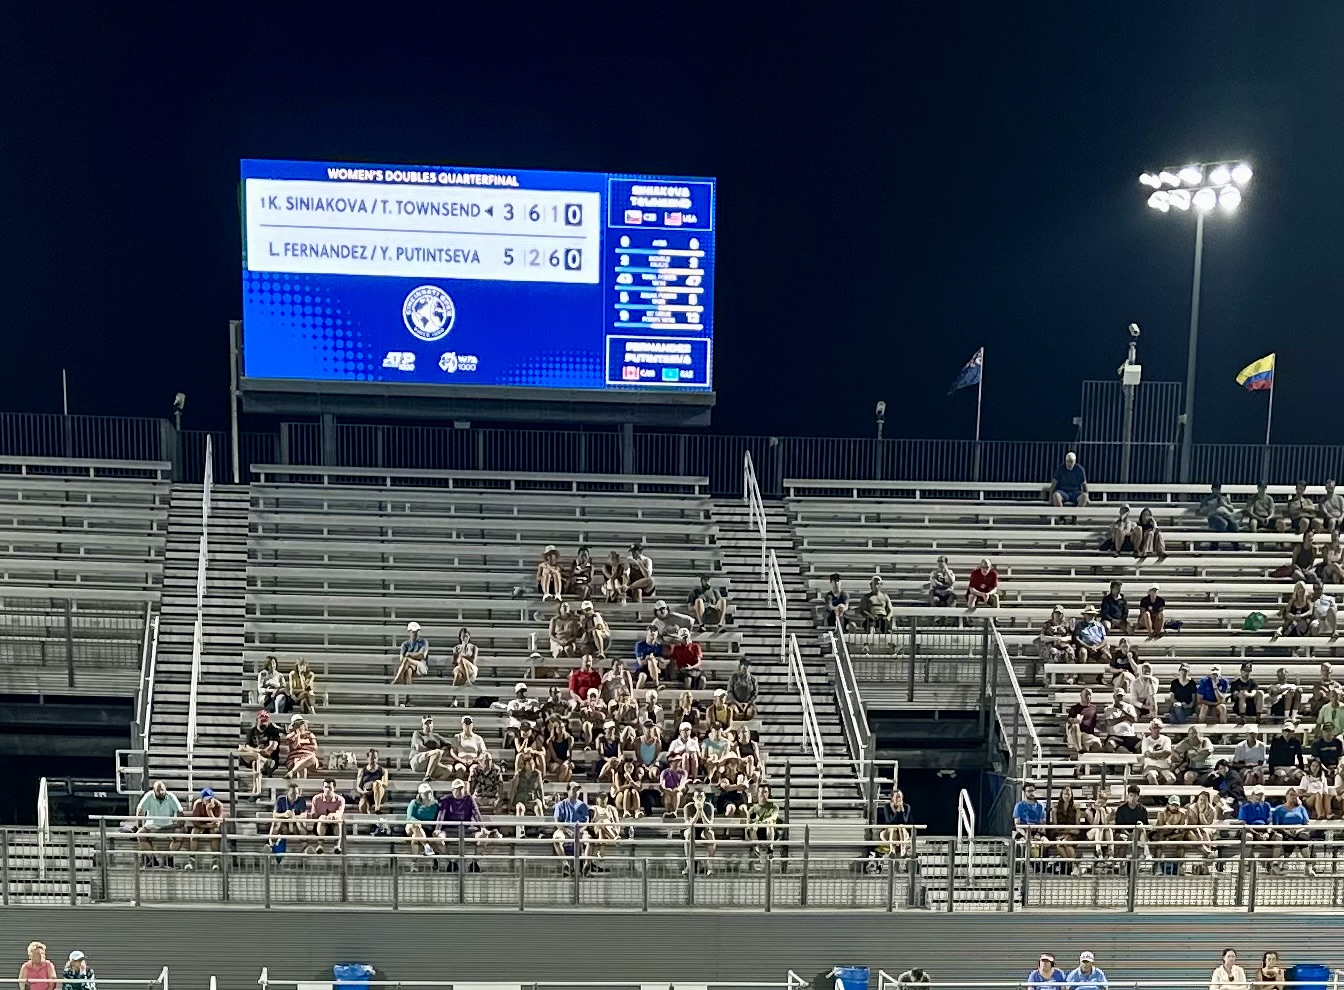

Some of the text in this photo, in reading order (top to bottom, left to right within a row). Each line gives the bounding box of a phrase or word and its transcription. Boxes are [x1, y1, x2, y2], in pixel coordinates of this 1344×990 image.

[327, 168, 519, 187] WOMEN'S DOUBLES QUARTERFINAL
[268, 196, 281, 210] K.
[285, 196, 368, 213] SINIAKOVA
[380, 199, 392, 214] T.
[396, 200, 480, 217] TOWNSEND
[503, 203, 514, 221] 3
[528, 203, 540, 222] 6
[268, 242, 280, 256] L.
[284, 242, 368, 260] FERNANDEZ
[379, 245, 392, 261] Y.
[396, 246, 480, 264] PUTINTSEVA
[503, 248, 514, 266] 5
[529, 248, 540, 267] 2
[549, 249, 560, 267] 6
